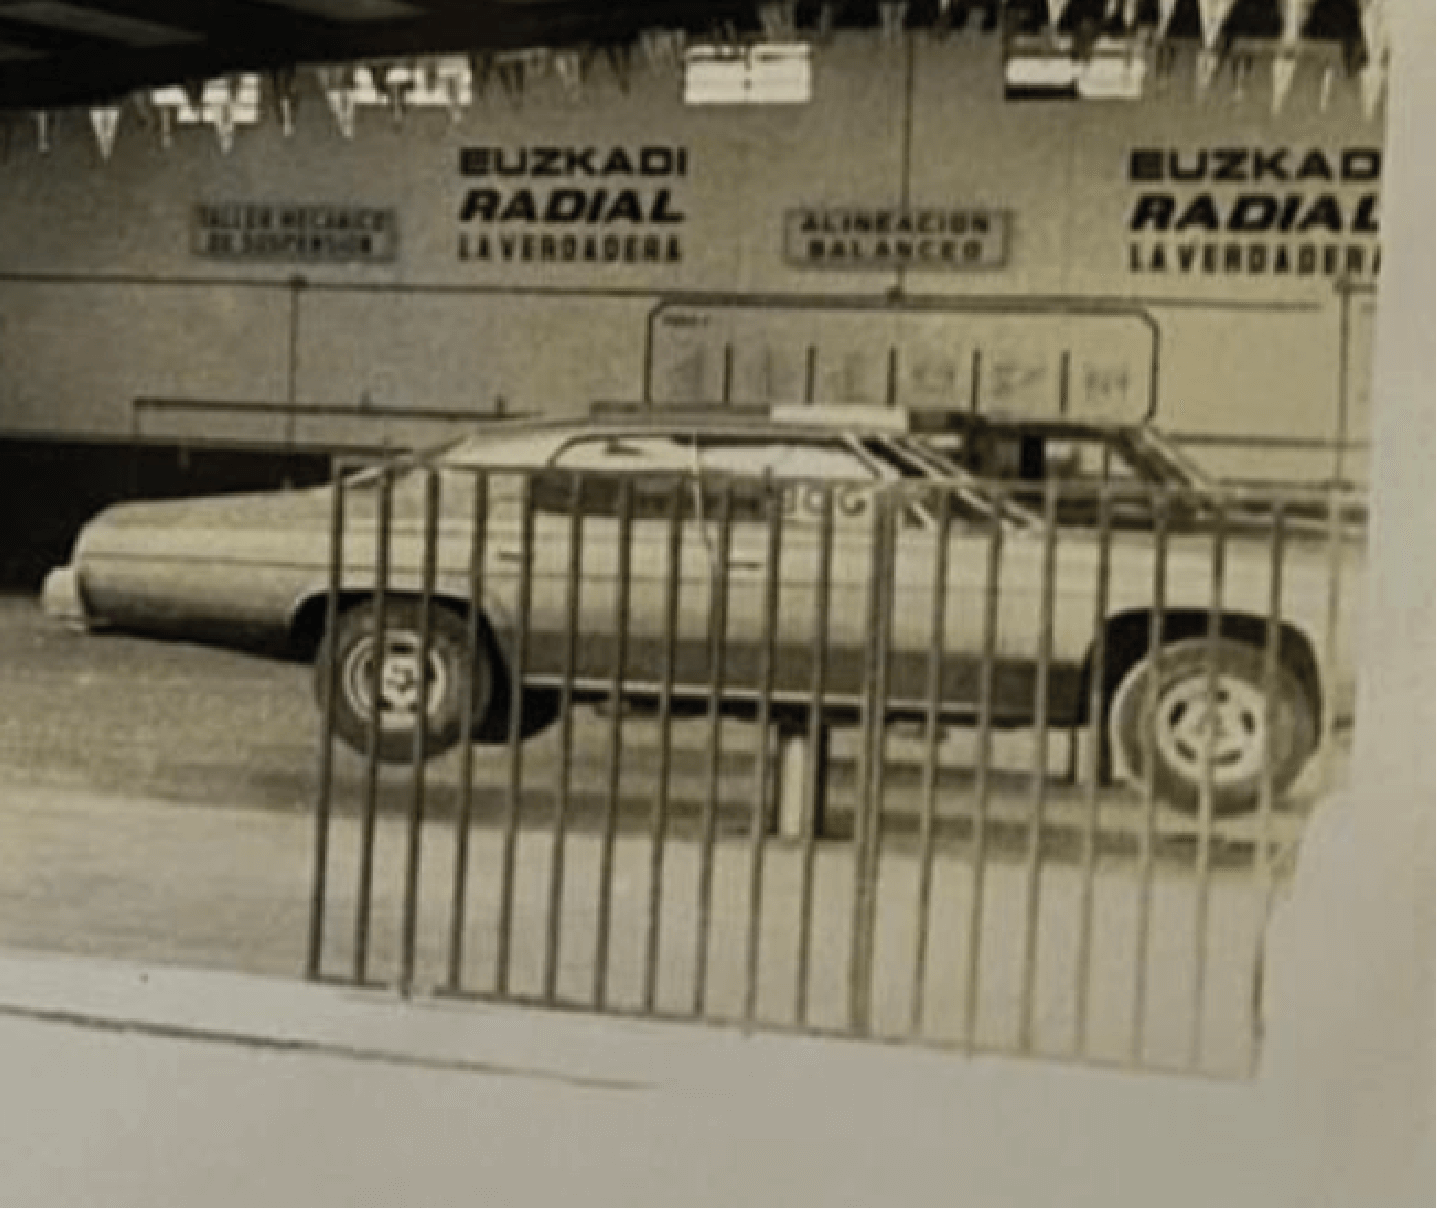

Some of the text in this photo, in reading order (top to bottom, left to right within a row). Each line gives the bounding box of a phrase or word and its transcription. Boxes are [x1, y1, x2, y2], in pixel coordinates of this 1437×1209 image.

[459, 146, 688, 178] EUZKADI
[459, 188, 686, 223] RADIAL
[1130, 192, 1380, 232] RADIAL
[799, 209, 991, 235] ALINEACION
[809, 240, 982, 263] BALANCEO
